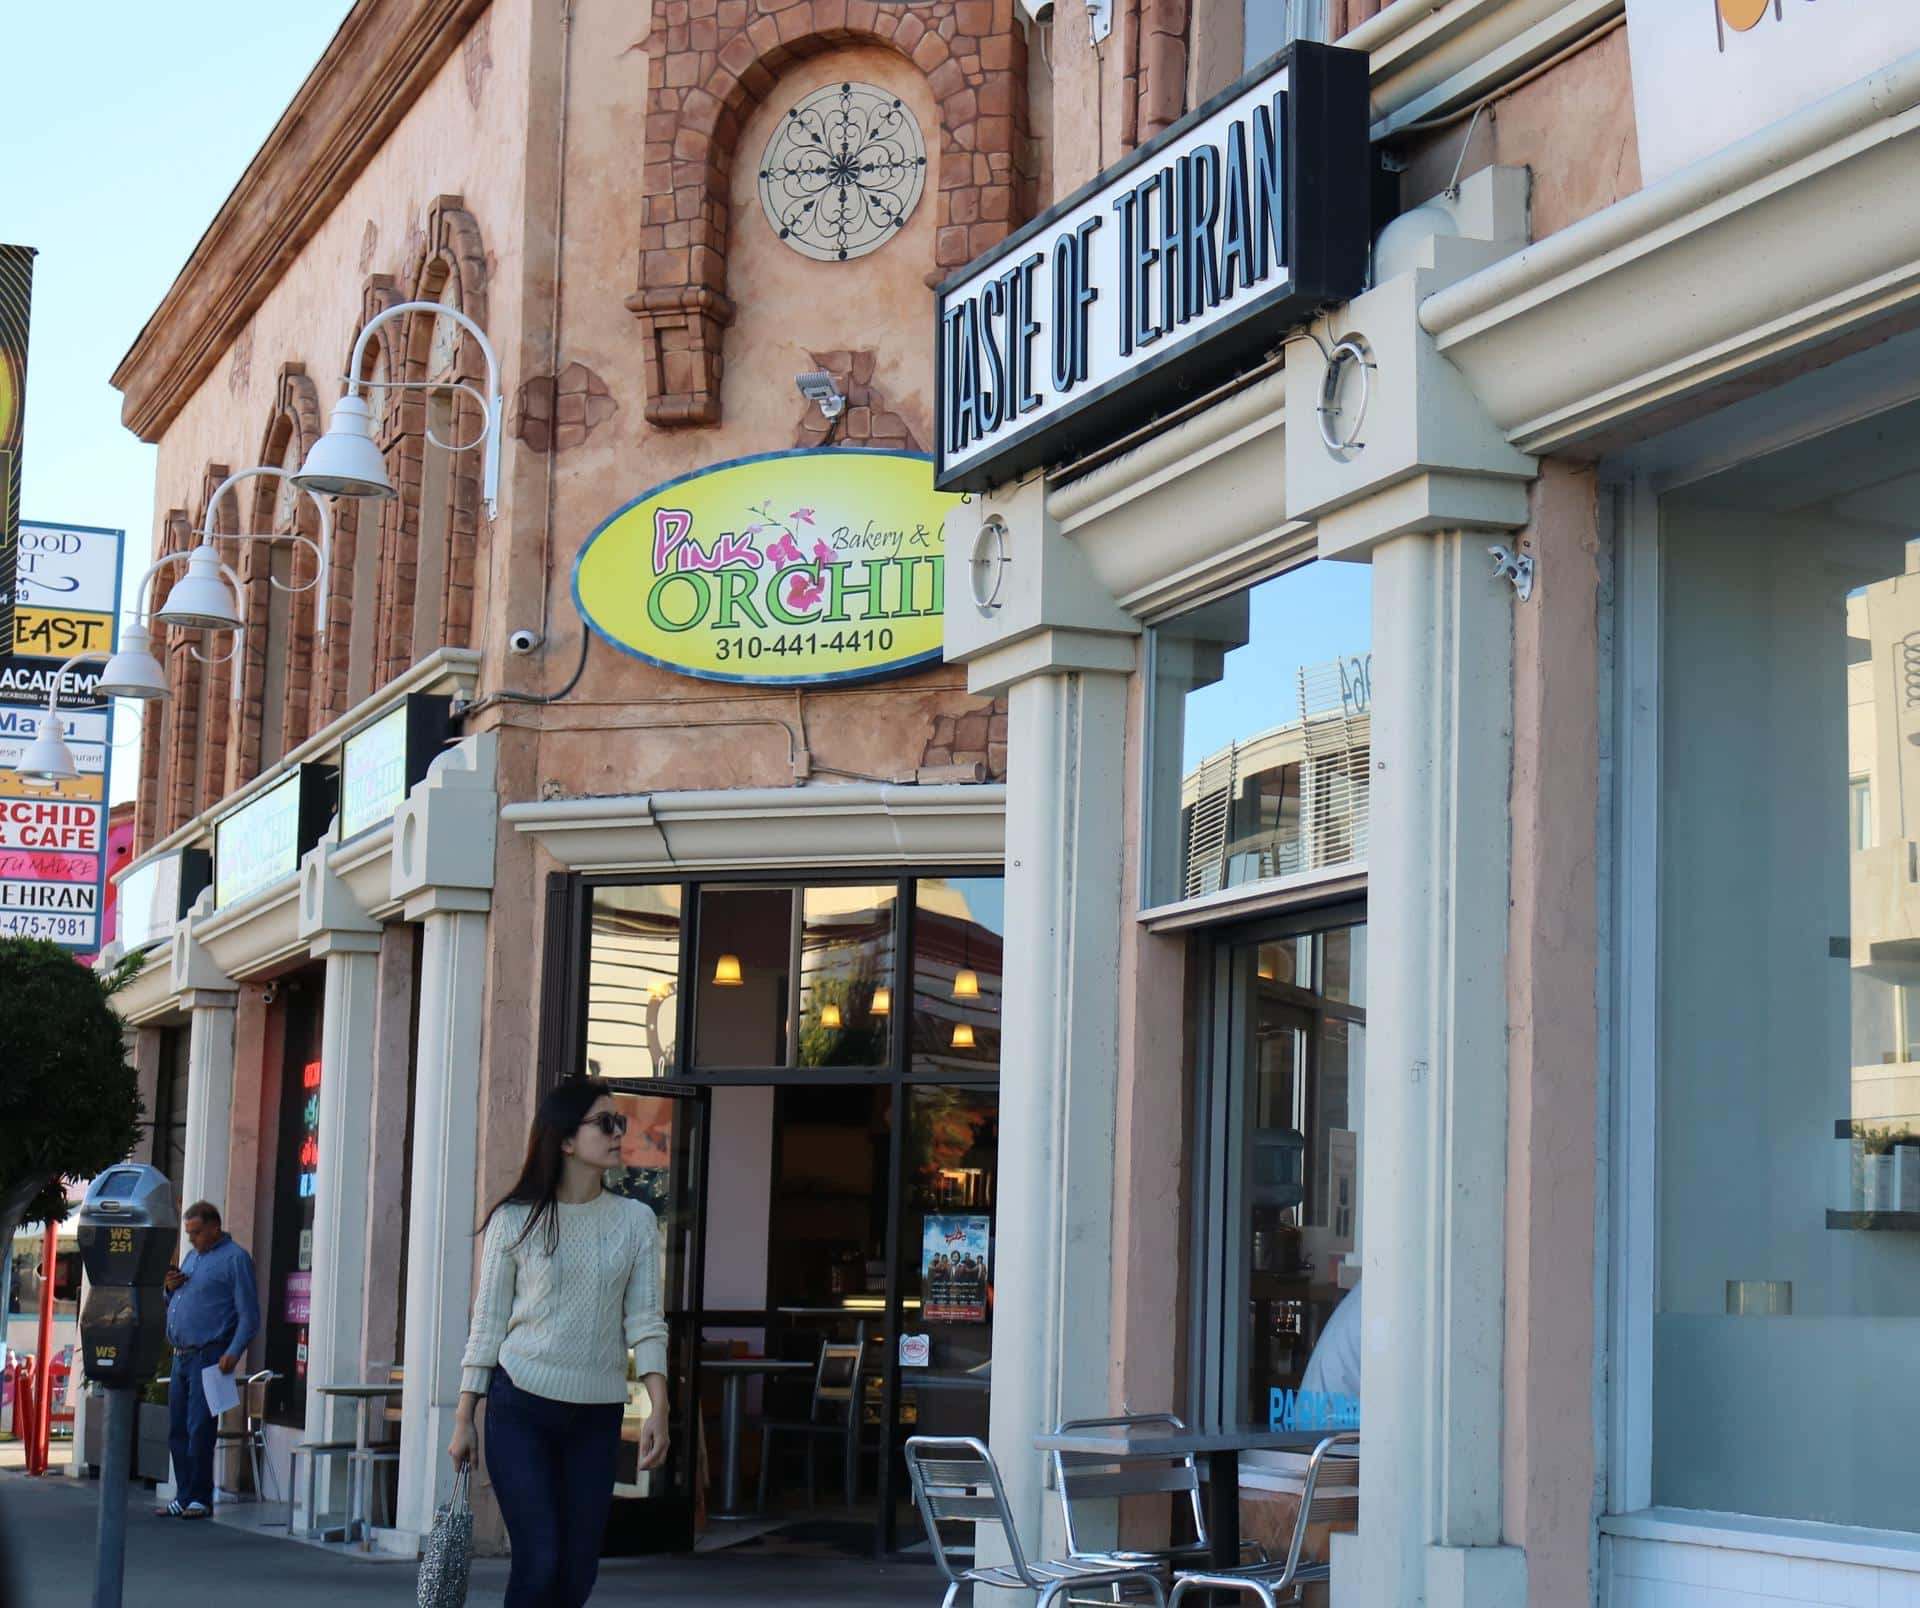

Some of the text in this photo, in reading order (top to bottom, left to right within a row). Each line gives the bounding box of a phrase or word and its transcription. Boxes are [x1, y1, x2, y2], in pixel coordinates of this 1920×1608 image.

[944, 90, 1288, 454] TASTE OF TEHRAN
[832, 520, 903, 559] Bakery
[909, 524, 930, 547] &
[15, 616, 104, 653] EAST
[715, 628, 893, 660] 310-441-4410
[0, 712, 75, 736] Mau
[20, 826, 95, 849] CAFE
[3, 885, 94, 908] EHRAN
[0, 915, 85, 937] -475-7981
[110, 1228, 131, 1240] WS
[110, 1241, 132, 1253] 251
[96, 1346, 117, 1358] WS
